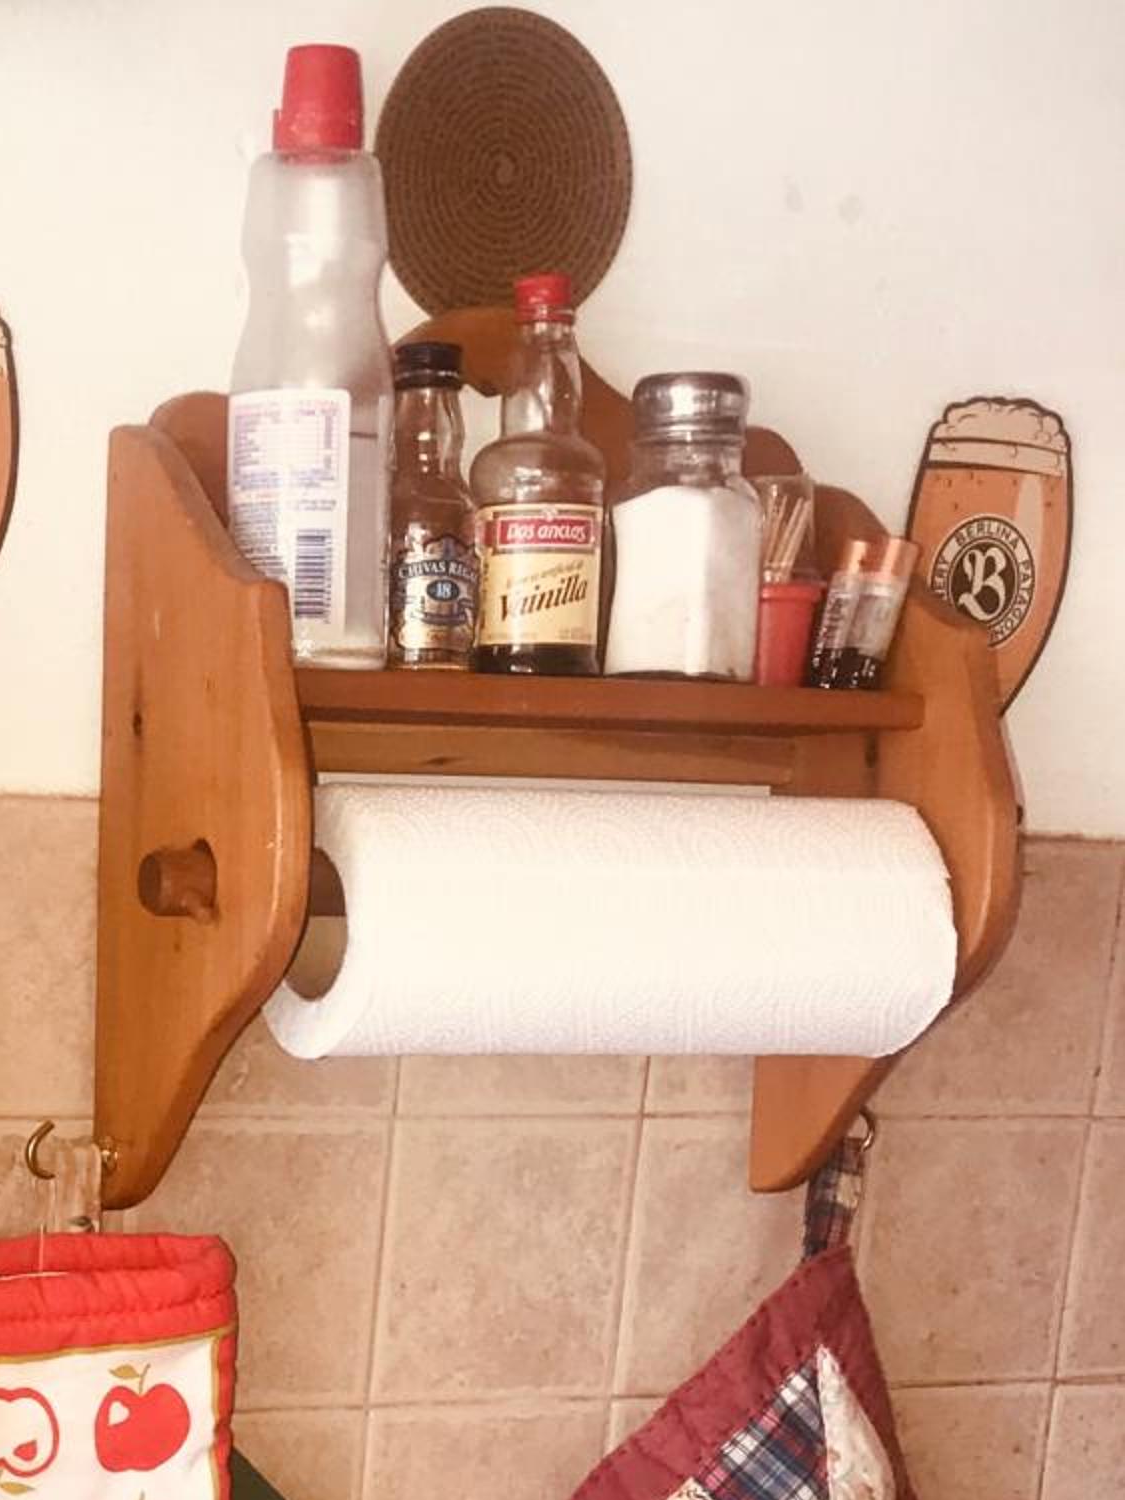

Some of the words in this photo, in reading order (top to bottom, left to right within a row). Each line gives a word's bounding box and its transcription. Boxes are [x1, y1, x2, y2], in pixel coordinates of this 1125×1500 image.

[398, 560, 446, 580] CHIVAS
[435, 581, 452, 599] 18
[955, 521, 1020, 550] BERLINA
[989, 559, 1033, 641] PATAGONI
